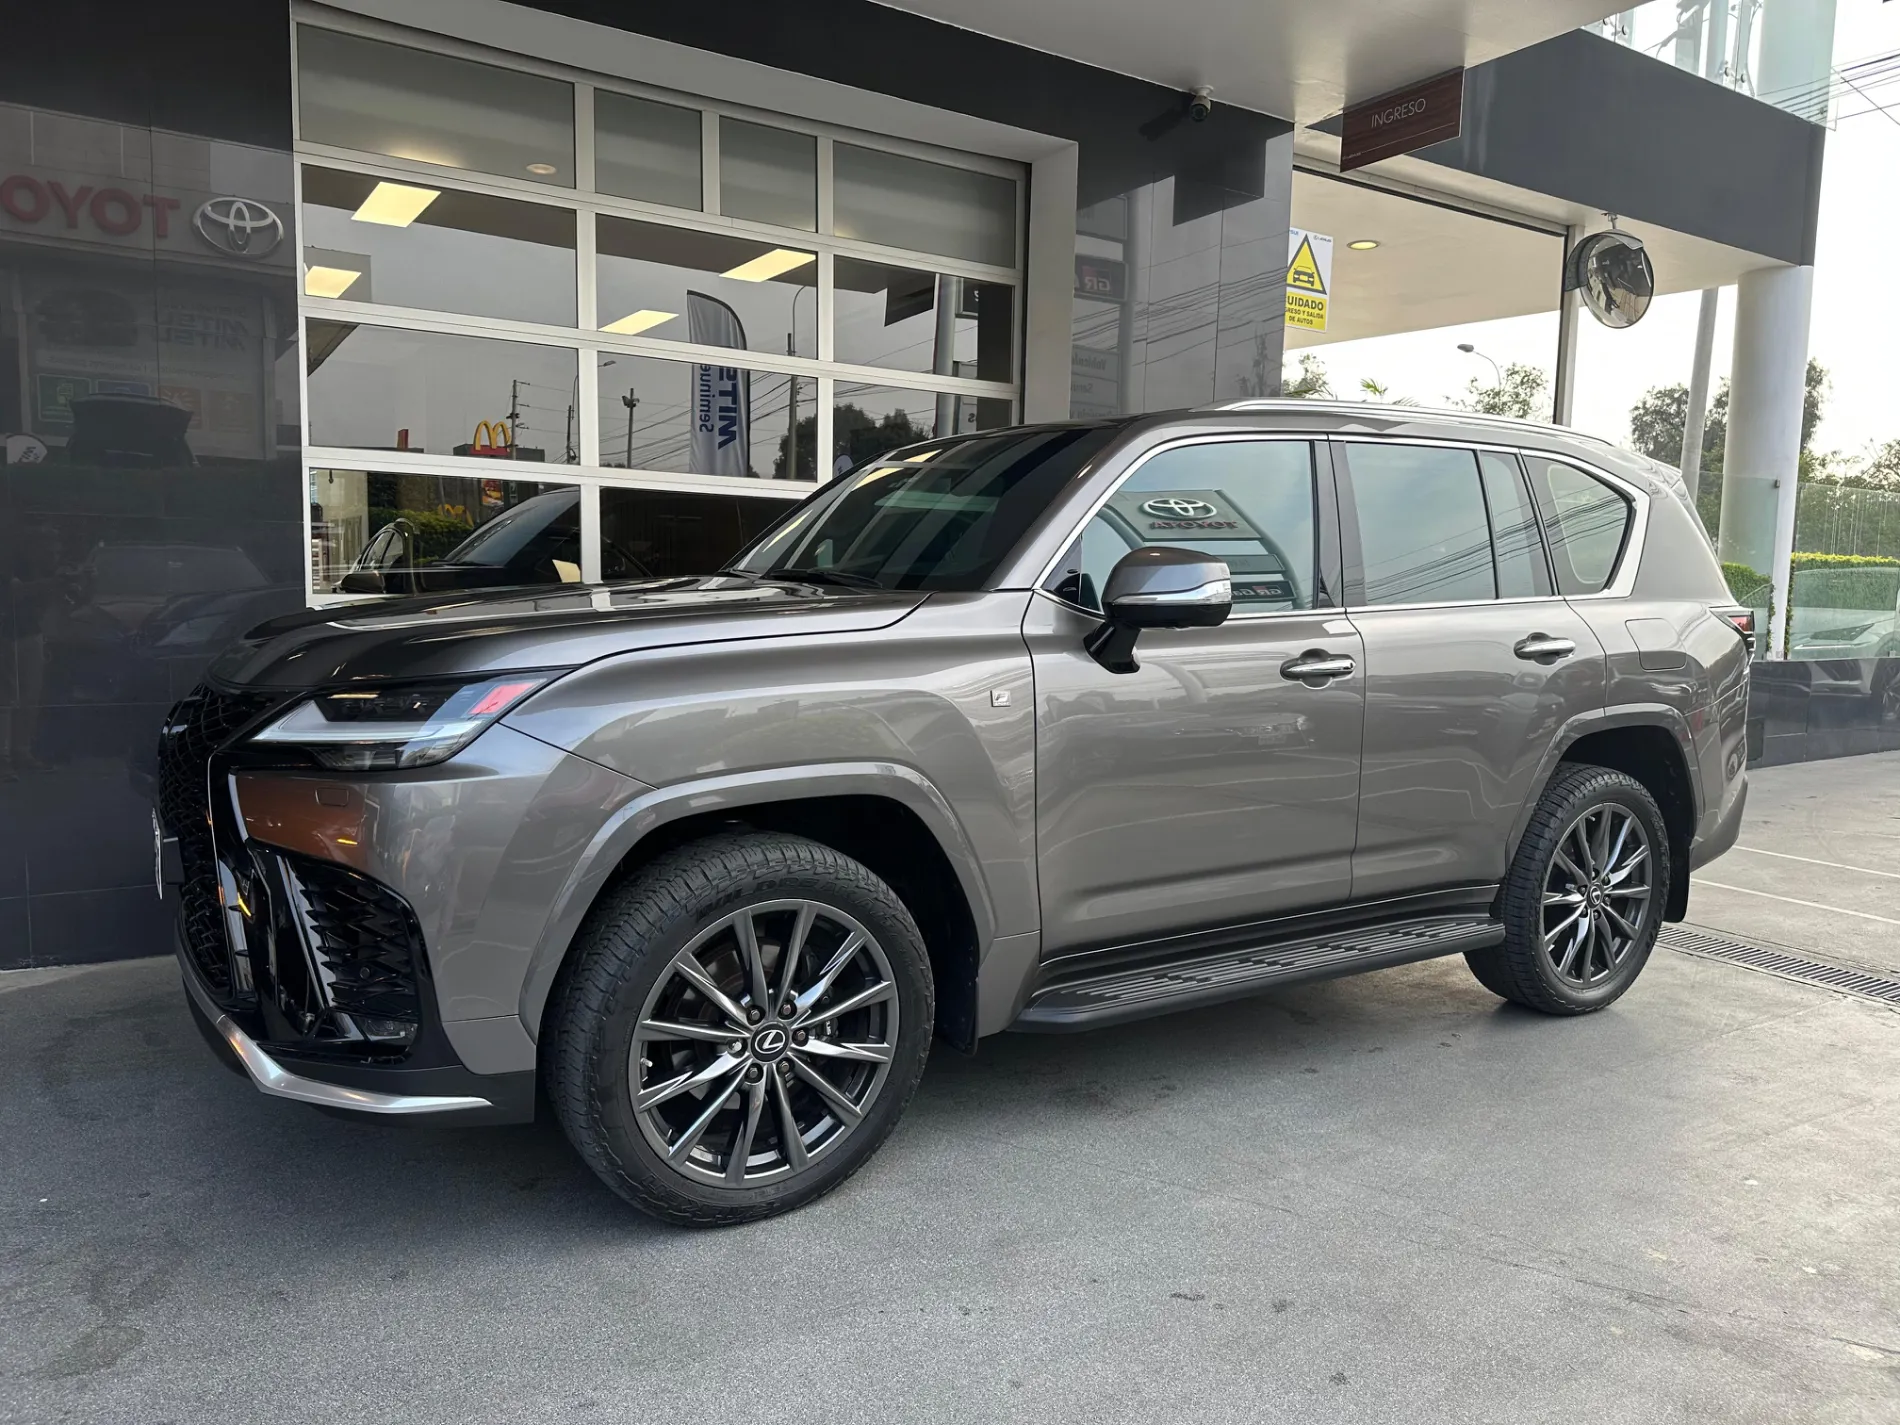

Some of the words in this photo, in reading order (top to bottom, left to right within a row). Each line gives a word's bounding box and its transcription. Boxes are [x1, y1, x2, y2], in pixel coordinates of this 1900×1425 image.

[1371, 98, 1426, 128] INGRESO
[1287, 295, 1324, 311] UIDADO
[1289, 315, 1296, 323] DE
[1297, 317, 1314, 325] AUTOS
